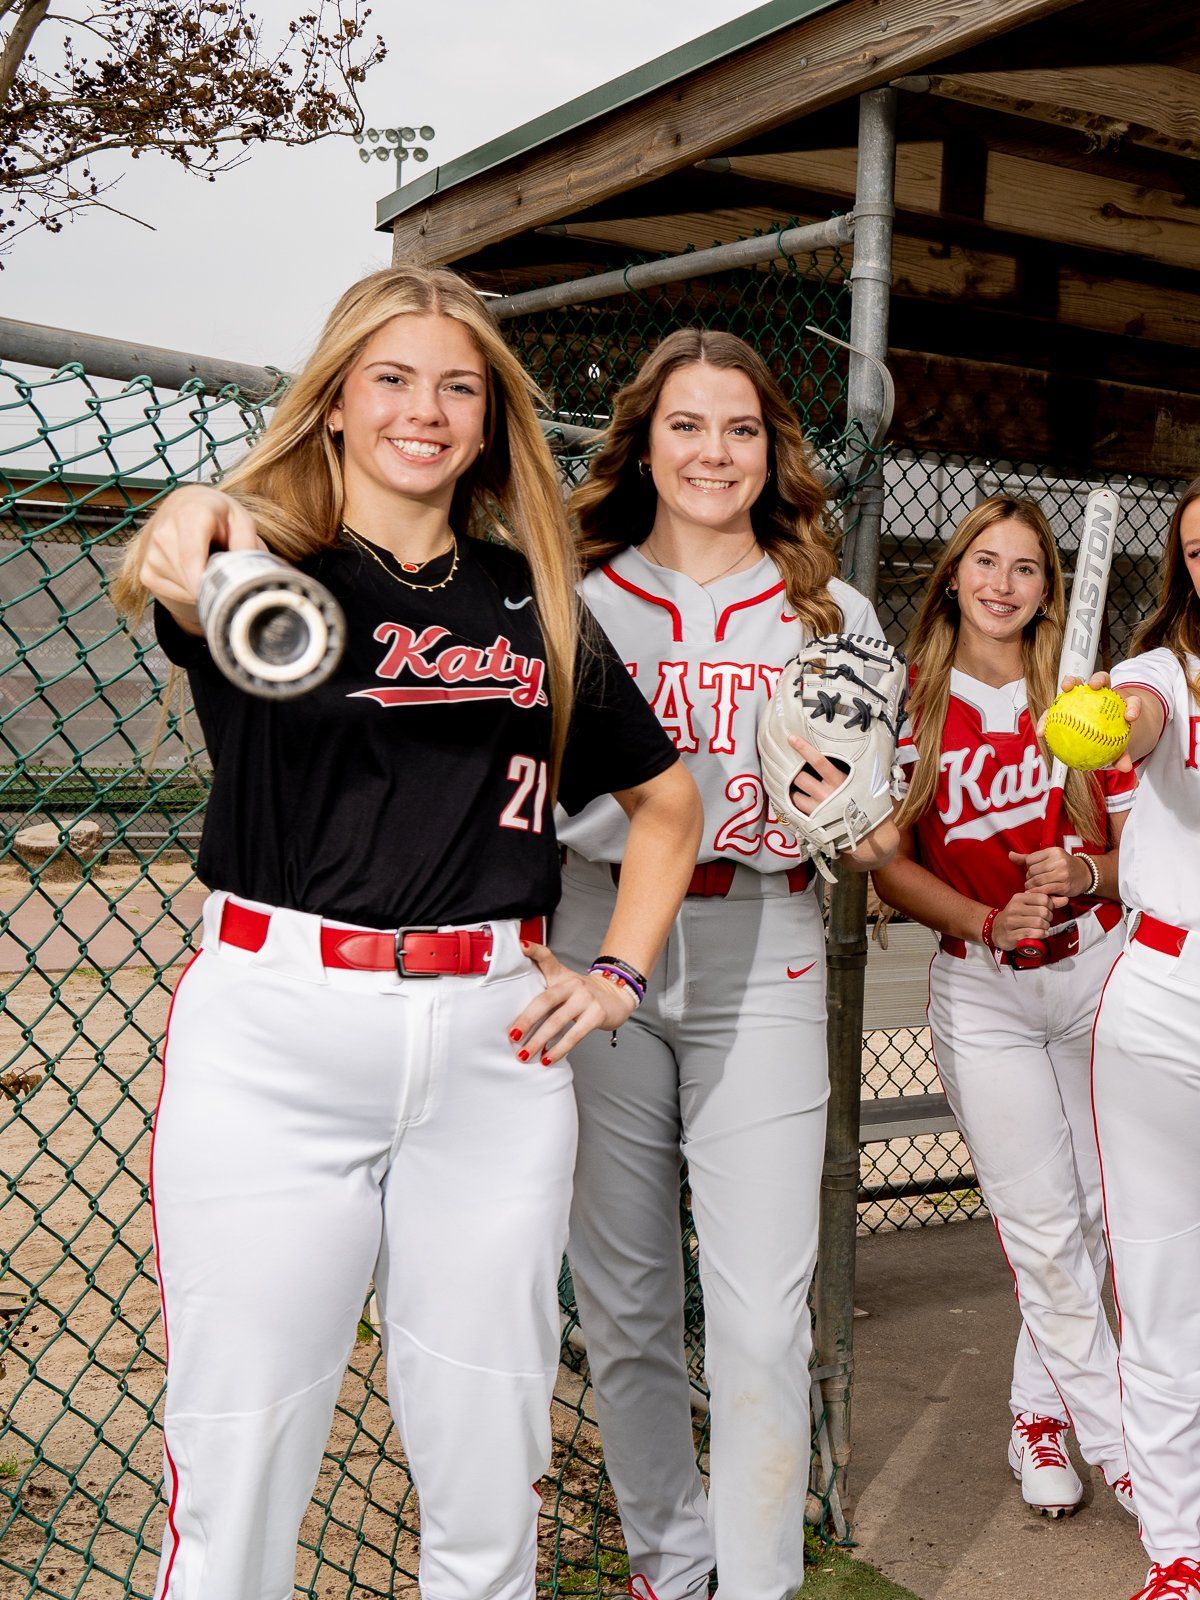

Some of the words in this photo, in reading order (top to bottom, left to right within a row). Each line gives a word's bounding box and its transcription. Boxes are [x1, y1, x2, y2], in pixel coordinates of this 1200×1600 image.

[1070, 504, 1113, 660] EASTON
[373, 622, 546, 708] Katy
[624, 661, 784, 754] AT
[498, 753, 548, 835] 21
